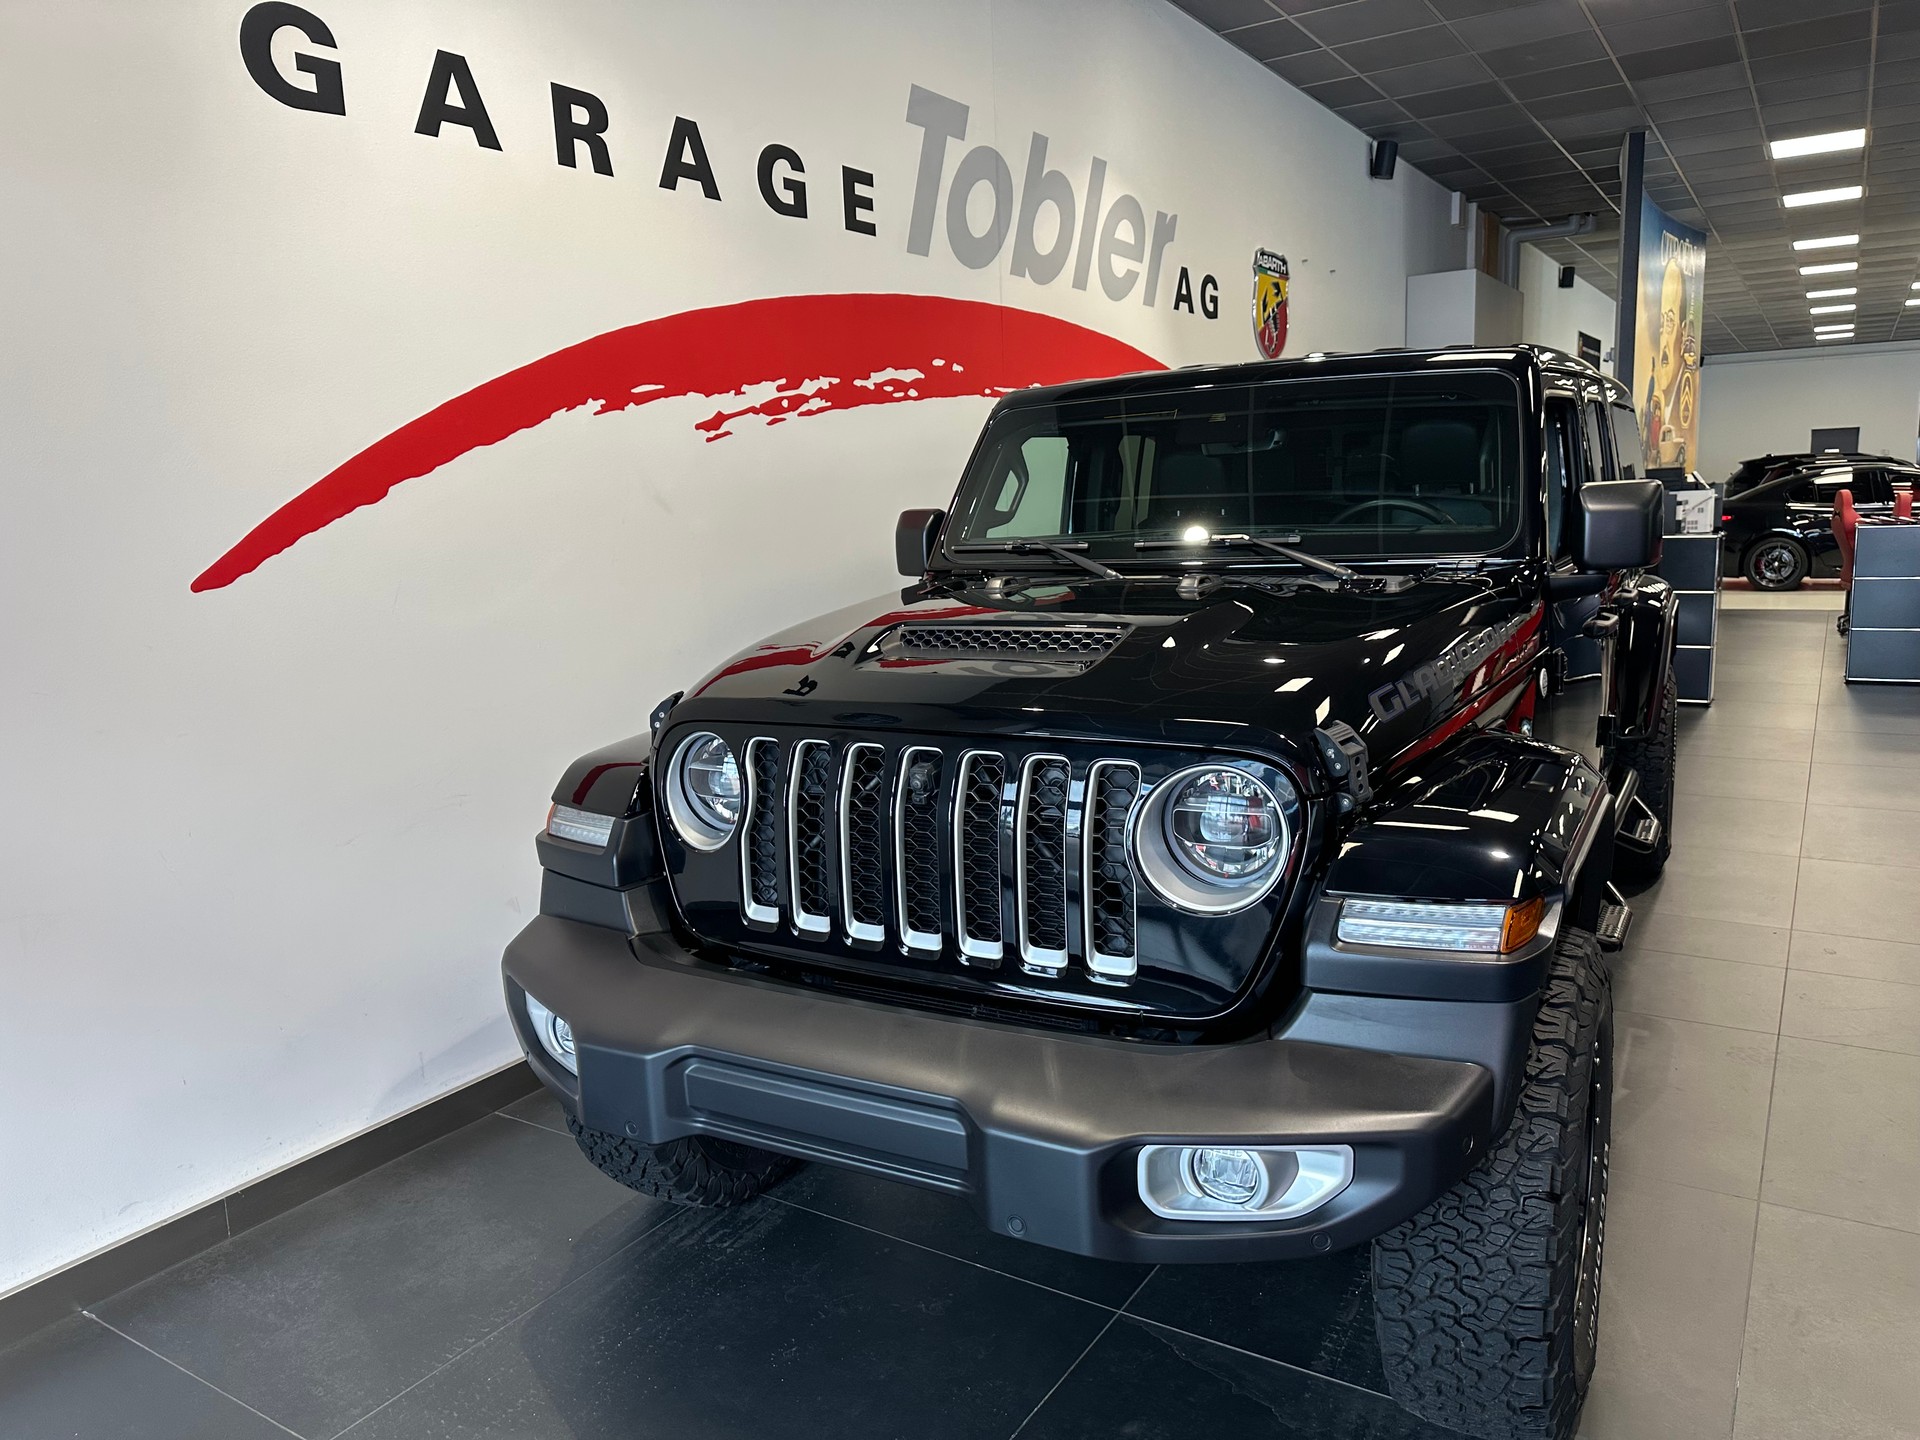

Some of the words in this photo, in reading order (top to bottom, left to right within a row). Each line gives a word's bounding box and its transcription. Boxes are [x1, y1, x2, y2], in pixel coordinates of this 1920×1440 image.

[239, 1, 877, 237] GARAGE
[906, 83, 1178, 308] Tobler
[1173, 266, 1219, 320] AG
[1259, 254, 1287, 274] ABARTH
[1368, 620, 1513, 723] GLADIATOR
